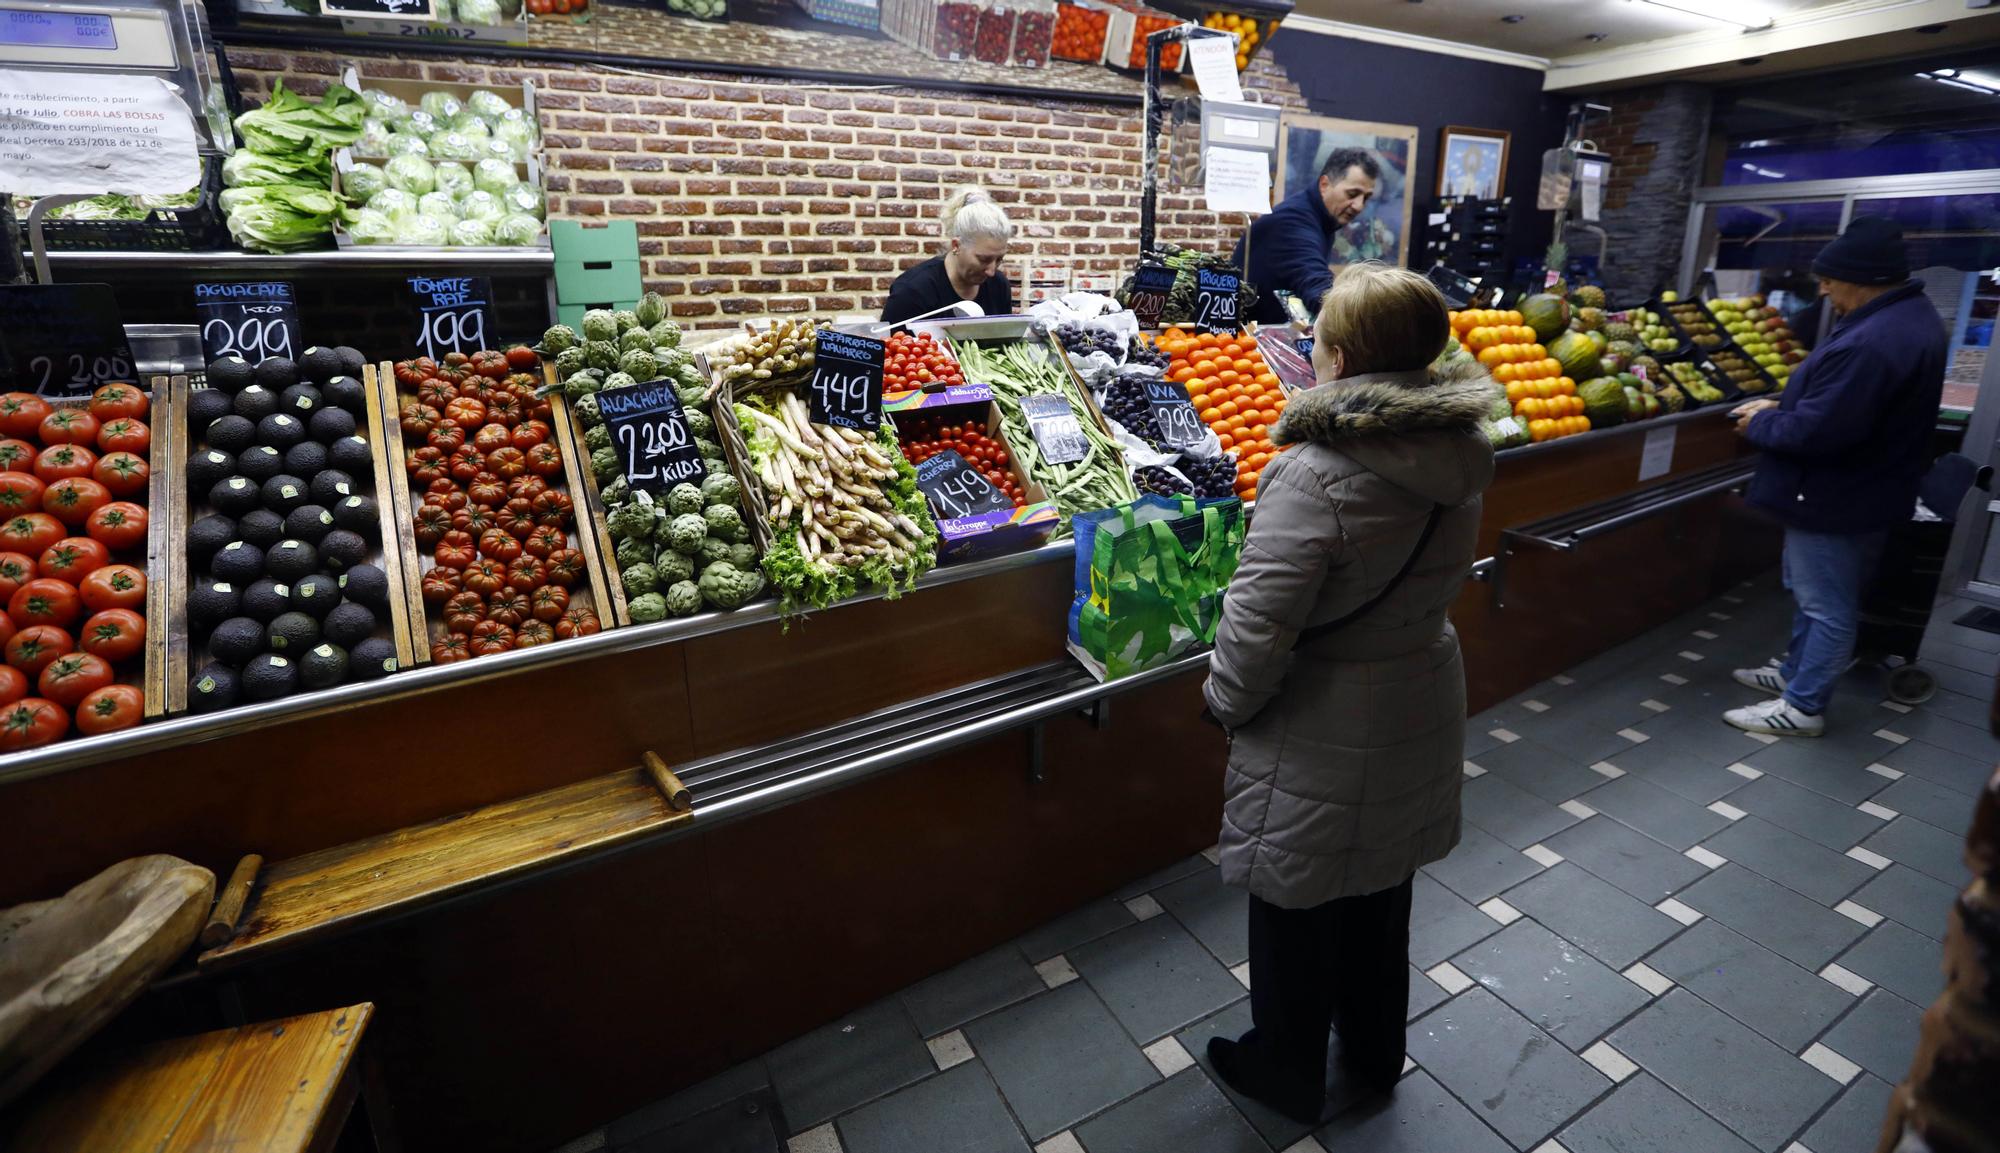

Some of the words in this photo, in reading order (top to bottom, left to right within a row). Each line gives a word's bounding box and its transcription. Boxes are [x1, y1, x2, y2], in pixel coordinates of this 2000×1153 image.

[13, 92, 99, 104] establecimiento,
[112, 96, 140, 105] partir
[15, 108, 30, 116] de
[63, 109, 100, 118] COBRA
[103, 111, 122, 119] LAS
[125, 111, 165, 121] BOLSAS
[68, 123, 140, 133] cumplimiento
[142, 126, 158, 134] del
[24, 136, 65, 146] Decreto
[67, 137, 117, 148] 293/2018
[119, 139, 132, 147] de
[135, 140, 147, 148] 12
[150, 140, 163, 149] de
[3, 152, 35, 161] mayo.
[195, 283, 291, 297] AGUACATE
[407, 277, 473, 293] TOMATE
[1147, 384, 1180, 399] UVA
[599, 385, 677, 415] ALCACHOFA
[919, 459, 957, 482] CHERRY
